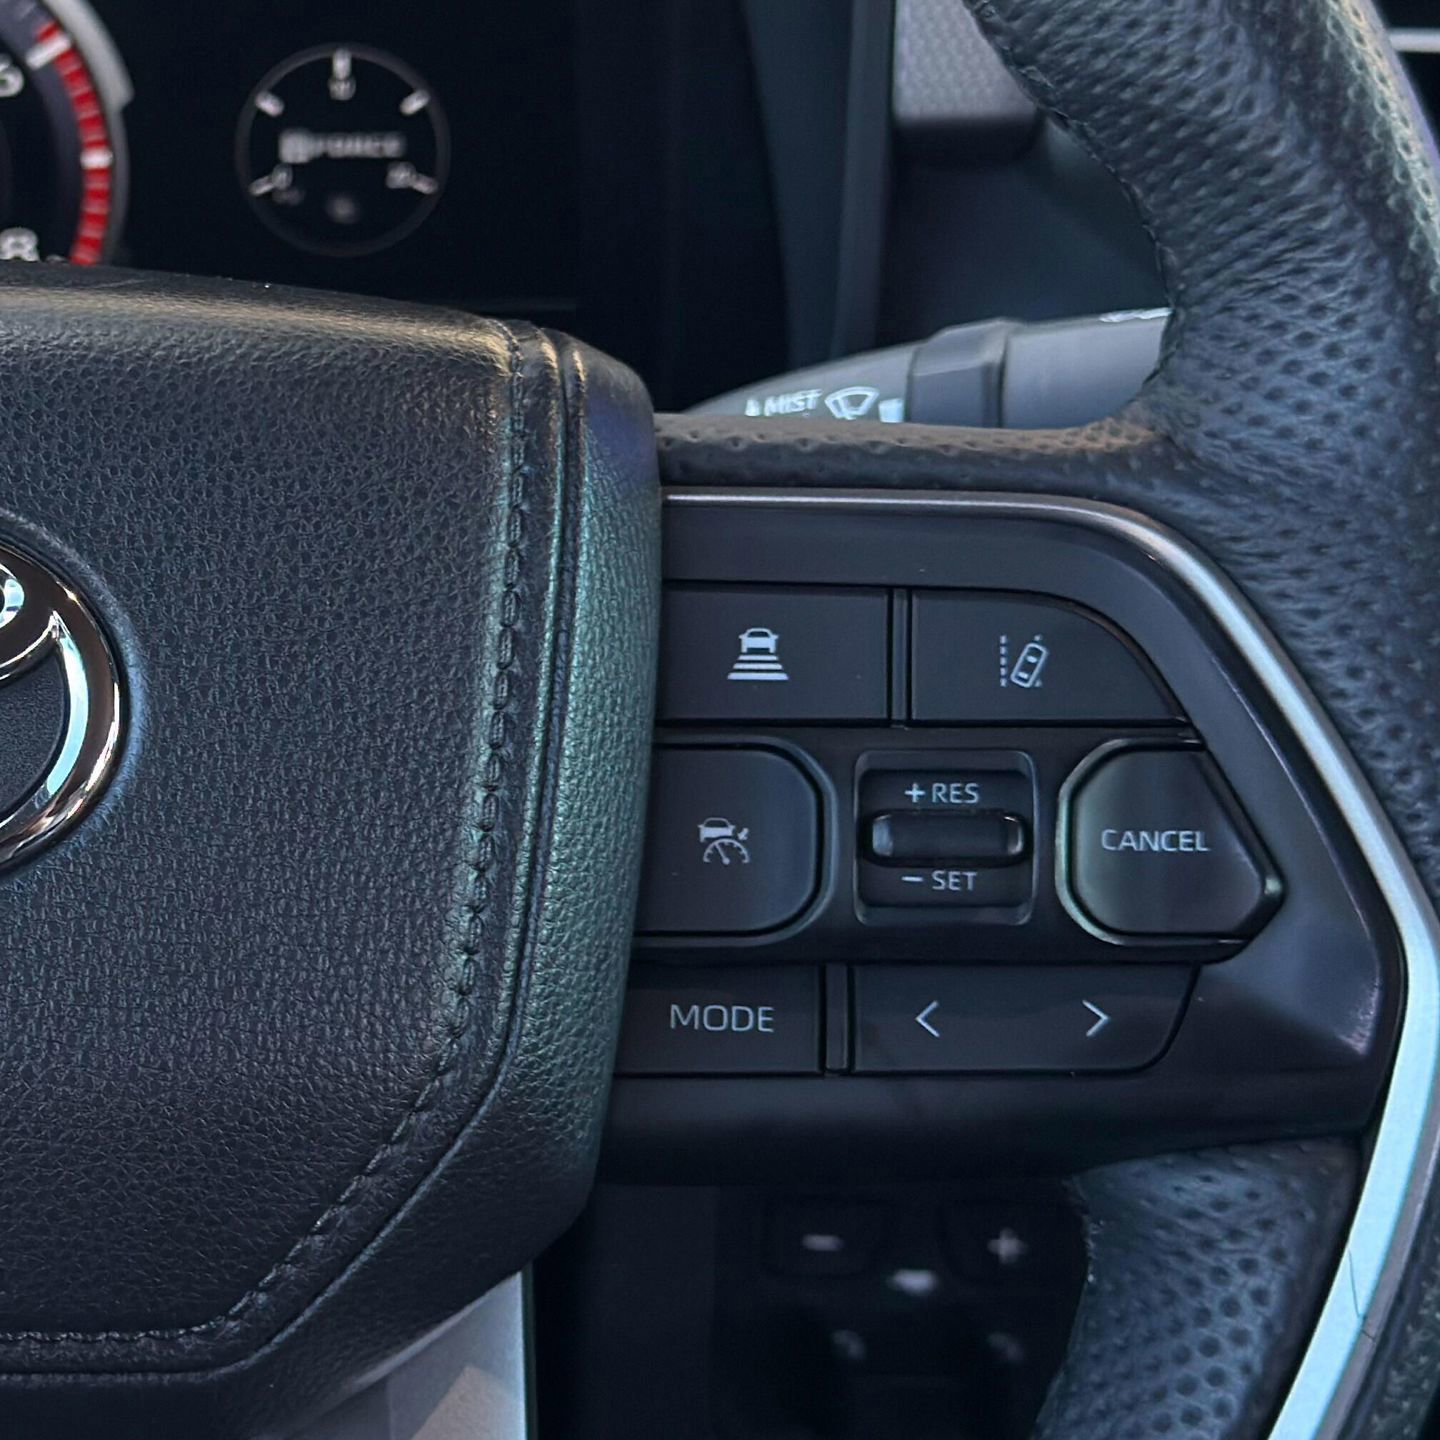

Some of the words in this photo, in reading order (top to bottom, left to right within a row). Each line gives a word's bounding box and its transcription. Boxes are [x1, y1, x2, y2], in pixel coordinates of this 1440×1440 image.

[764, 389, 822, 417] MIST
[932, 782, 980, 805] RES
[1100, 827, 1211, 854] CANCEL
[932, 870, 977, 893] SET
[669, 1003, 775, 1033] MODE
